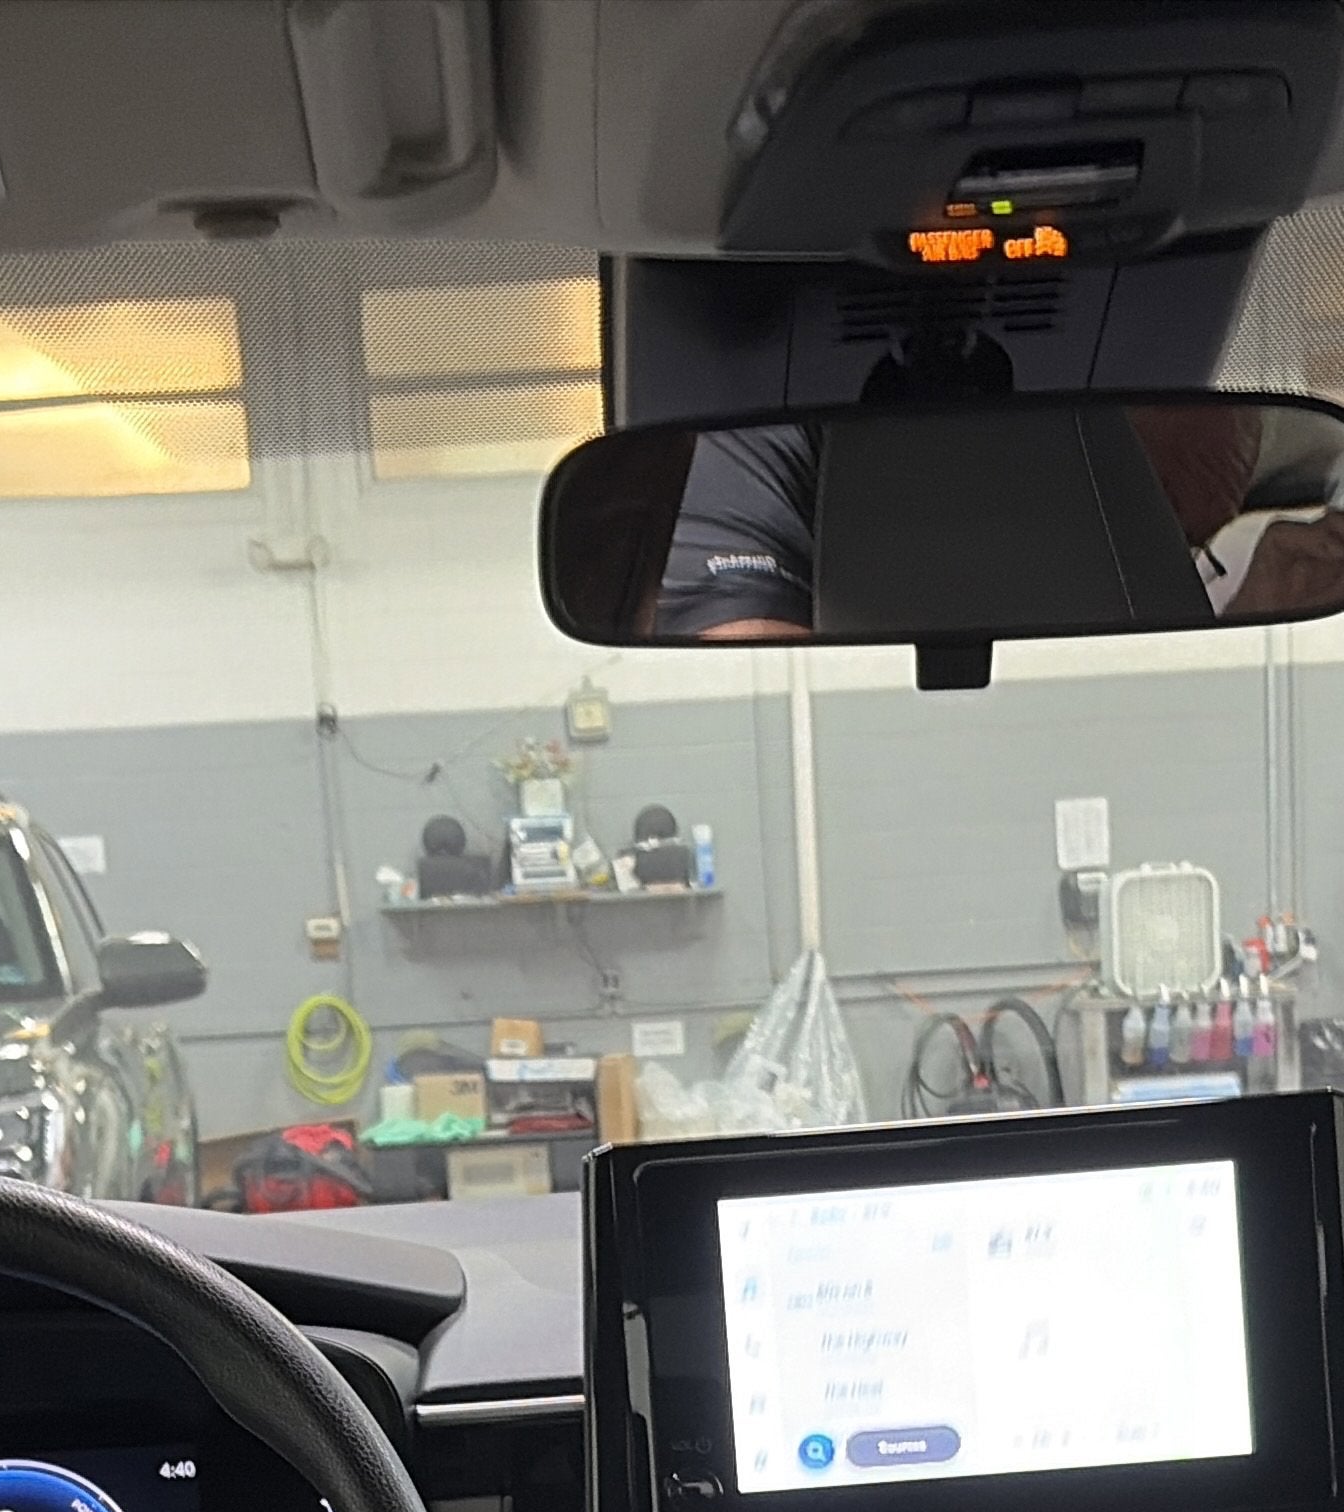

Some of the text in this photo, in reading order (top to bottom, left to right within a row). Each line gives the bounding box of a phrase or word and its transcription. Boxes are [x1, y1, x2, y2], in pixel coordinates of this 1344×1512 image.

[910, 229, 993, 252] PASSENGER
[1005, 238, 1034, 258] OFF
[159, 1460, 196, 1478] 4:40
